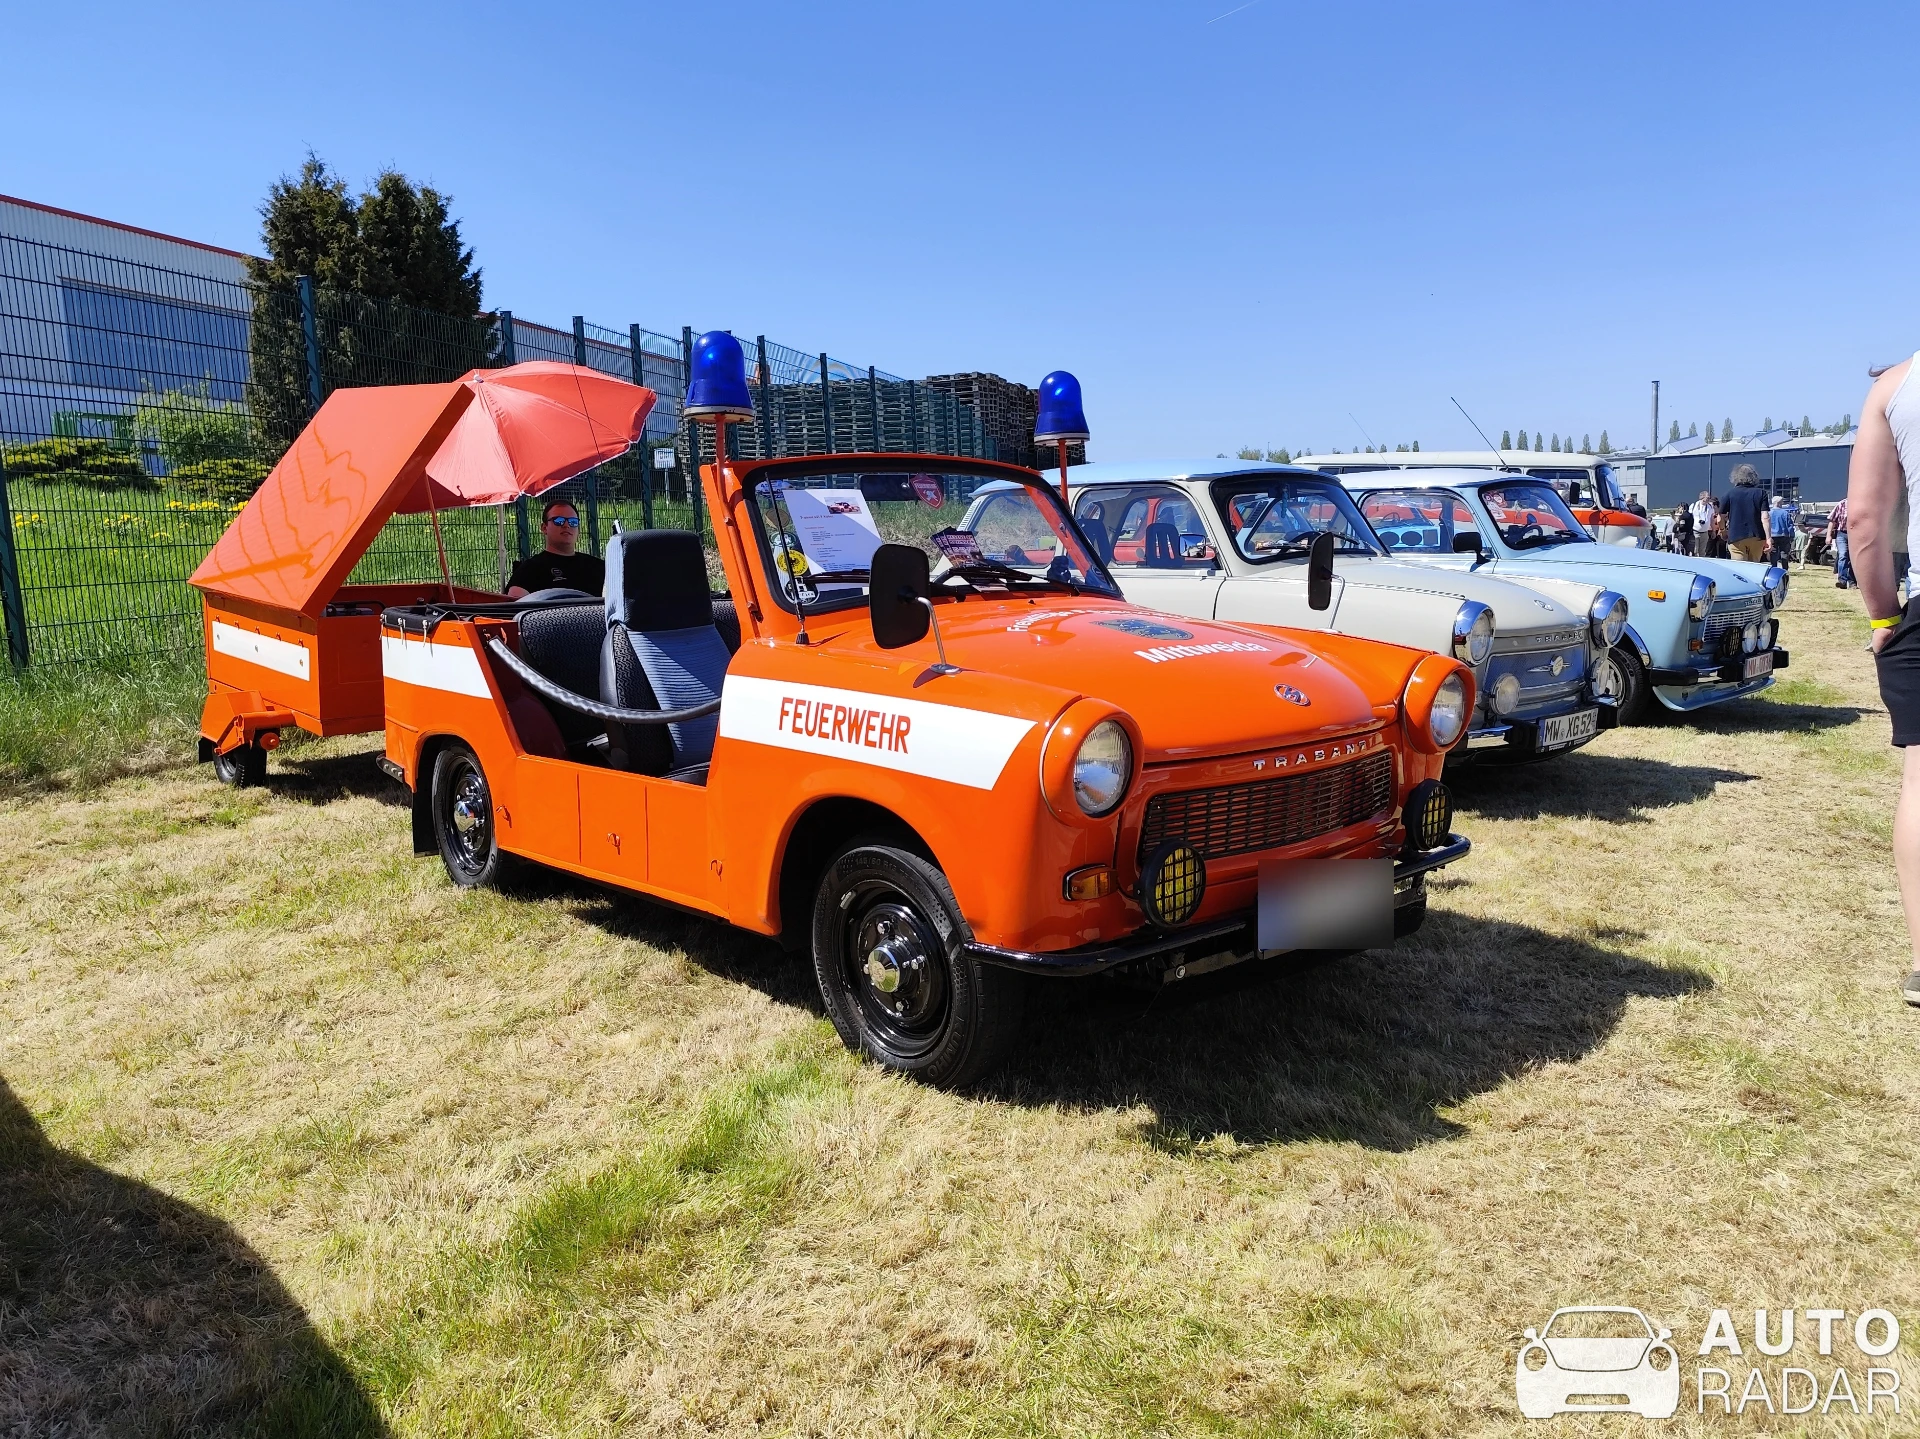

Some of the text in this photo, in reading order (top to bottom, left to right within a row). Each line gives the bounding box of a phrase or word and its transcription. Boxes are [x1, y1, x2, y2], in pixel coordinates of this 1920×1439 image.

[1134, 641, 1272, 663] Mittweida
[779, 697, 911, 754] FEUERWEHR
[1545, 720, 1561, 742] MW
[1253, 740, 1367, 771] TRABANT
[927, 1015, 965, 1079] KUMHO
